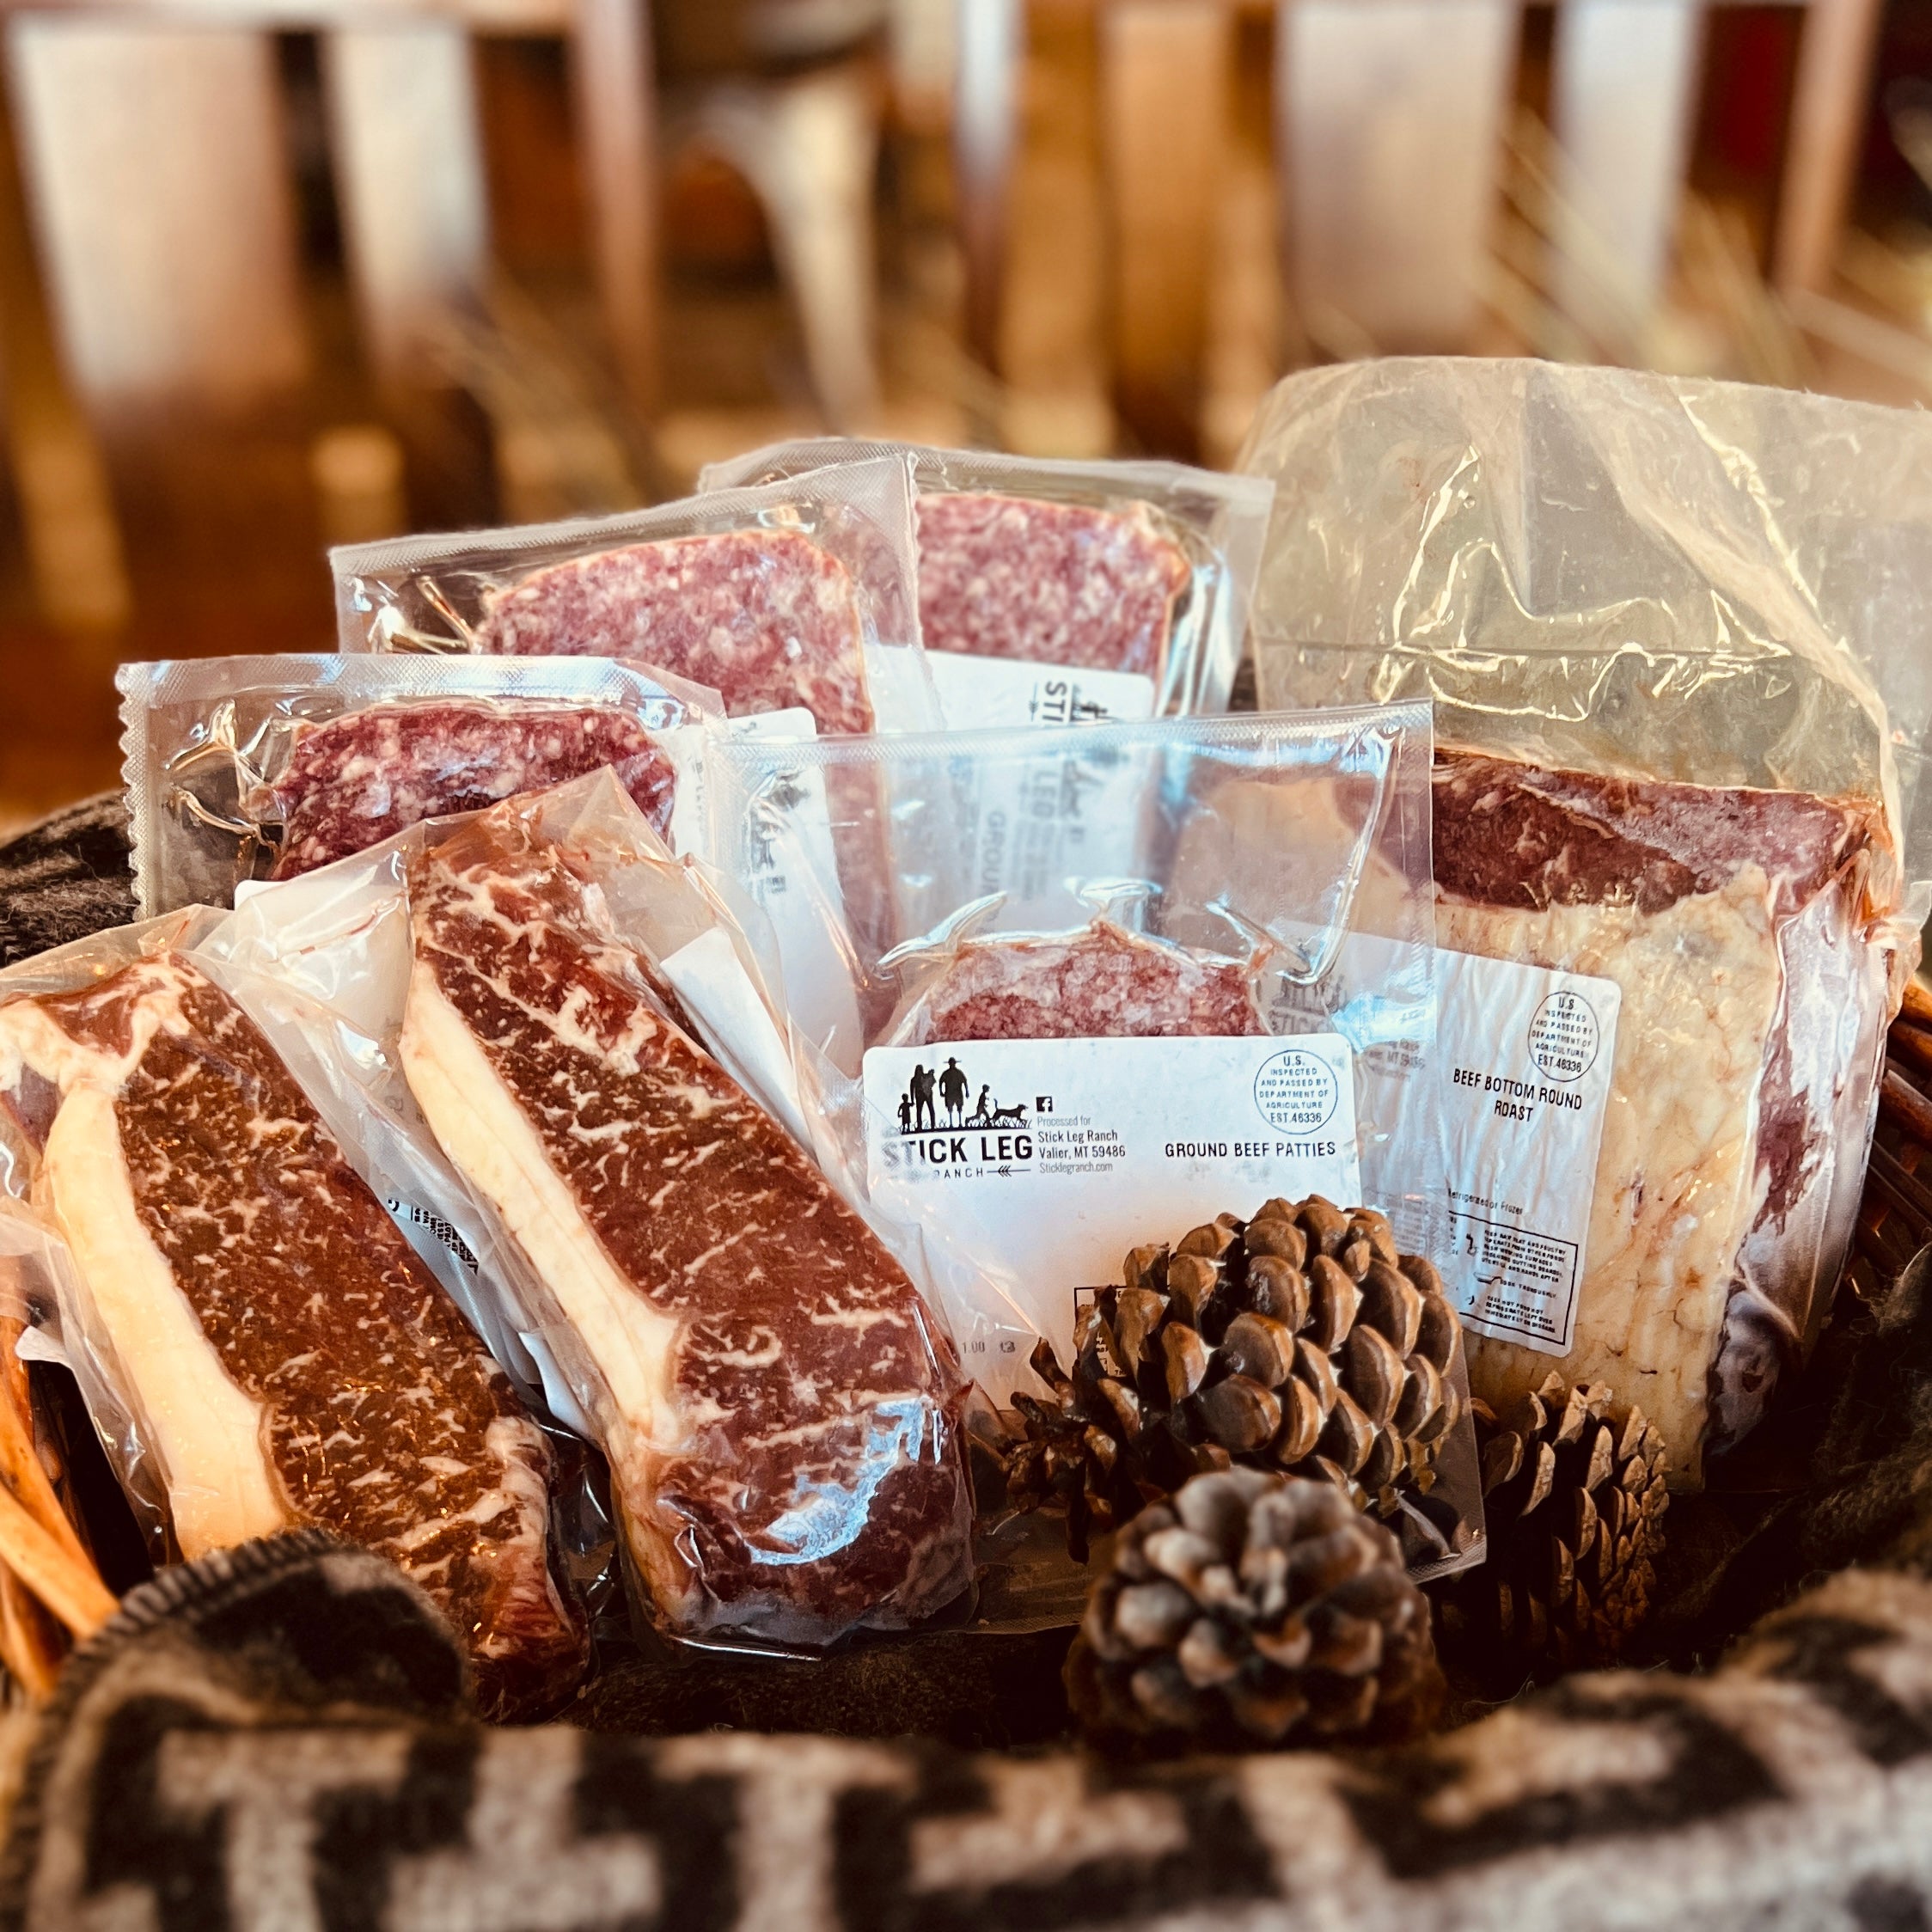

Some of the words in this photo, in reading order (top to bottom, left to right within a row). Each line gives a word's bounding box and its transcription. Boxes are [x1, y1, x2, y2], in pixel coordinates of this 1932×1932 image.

[1042, 681, 1067, 722] STI
[1550, 1022, 1580, 1033] PASSED
[1284, 1055, 1305, 1066] U.S.
[1270, 1067, 1317, 1076] INSPECTED
[1453, 1068, 1482, 1087] BEEF
[1484, 1076, 1535, 1100] BOTTOM
[1538, 1087, 1582, 1110] ROUND
[1494, 1100, 1533, 1122] ROAST
[1037, 1116, 1078, 1128] Processed
[1080, 1116, 1091, 1126] for
[1038, 1130, 1064, 1143] Stick
[1067, 1131, 1085, 1145] Leg
[1087, 1129, 1117, 1142] Ranch
[882, 1137, 968, 1167] STICK
[981, 1135, 1032, 1161] LEG
[1039, 1146, 1071, 1160] Valier,
[1074, 1146, 1088, 1159] MT
[1091, 1145, 1126, 1158] 59486
[1165, 1142, 1227, 1157] GROUND
[1234, 1142, 1270, 1157] BEEF
[1276, 1141, 1336, 1157] PATTIES
[1040, 1161, 1113, 1175] Sticklegranch.com
